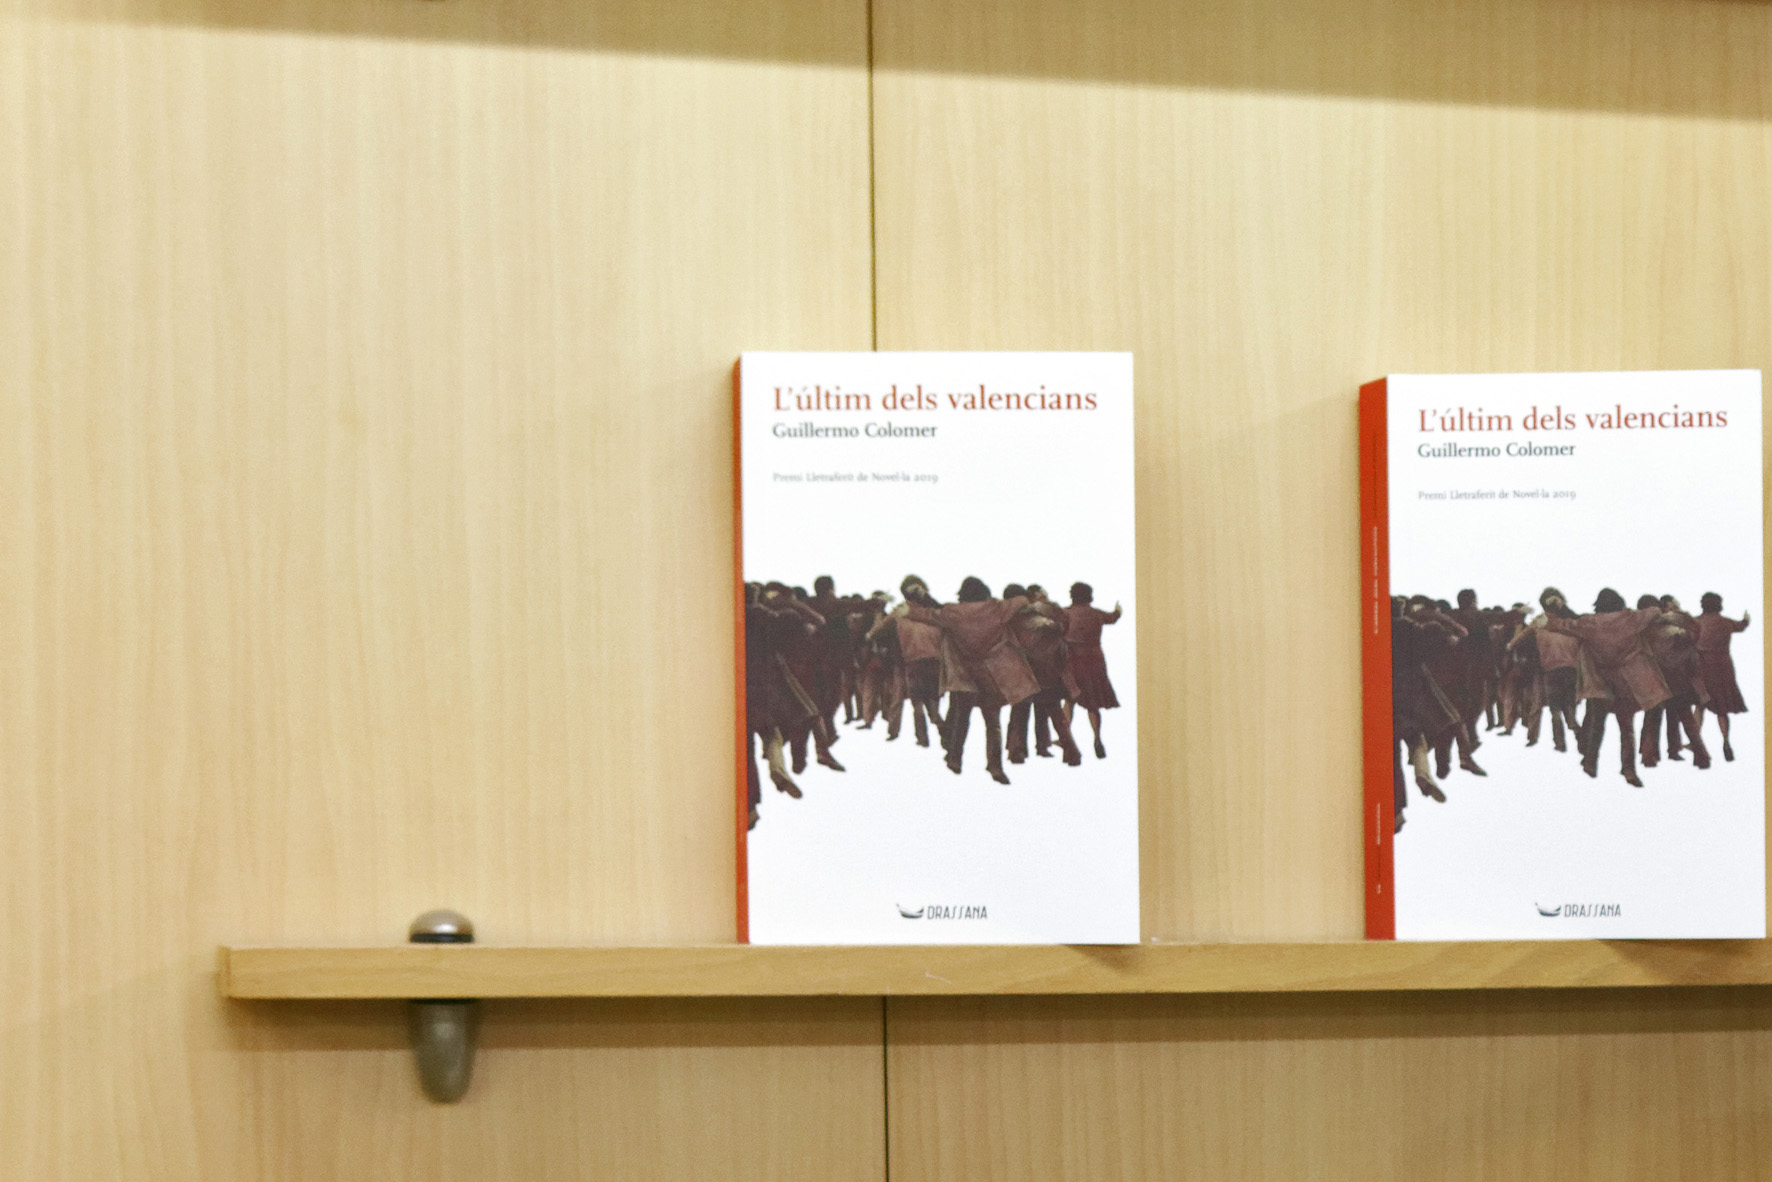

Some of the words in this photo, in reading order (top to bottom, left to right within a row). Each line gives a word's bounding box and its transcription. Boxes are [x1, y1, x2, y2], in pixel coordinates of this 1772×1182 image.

[774, 384, 872, 411] L'últim
[881, 384, 938, 411] dels
[947, 383, 1098, 411] valencians
[1419, 406, 1513, 433] L'últim
[1522, 405, 1577, 431] dels
[1585, 403, 1728, 430] valencians
[771, 421, 860, 439] Guillermo
[864, 421, 938, 438] Colomer
[1417, 442, 1502, 458] Guillermo
[1505, 440, 1576, 457] Colomer
[1417, 490, 1447, 501] Premi
[1449, 489, 1497, 501] Lletraferit
[1497, 489, 1510, 500] de
[1552, 490, 1577, 501] 2019
